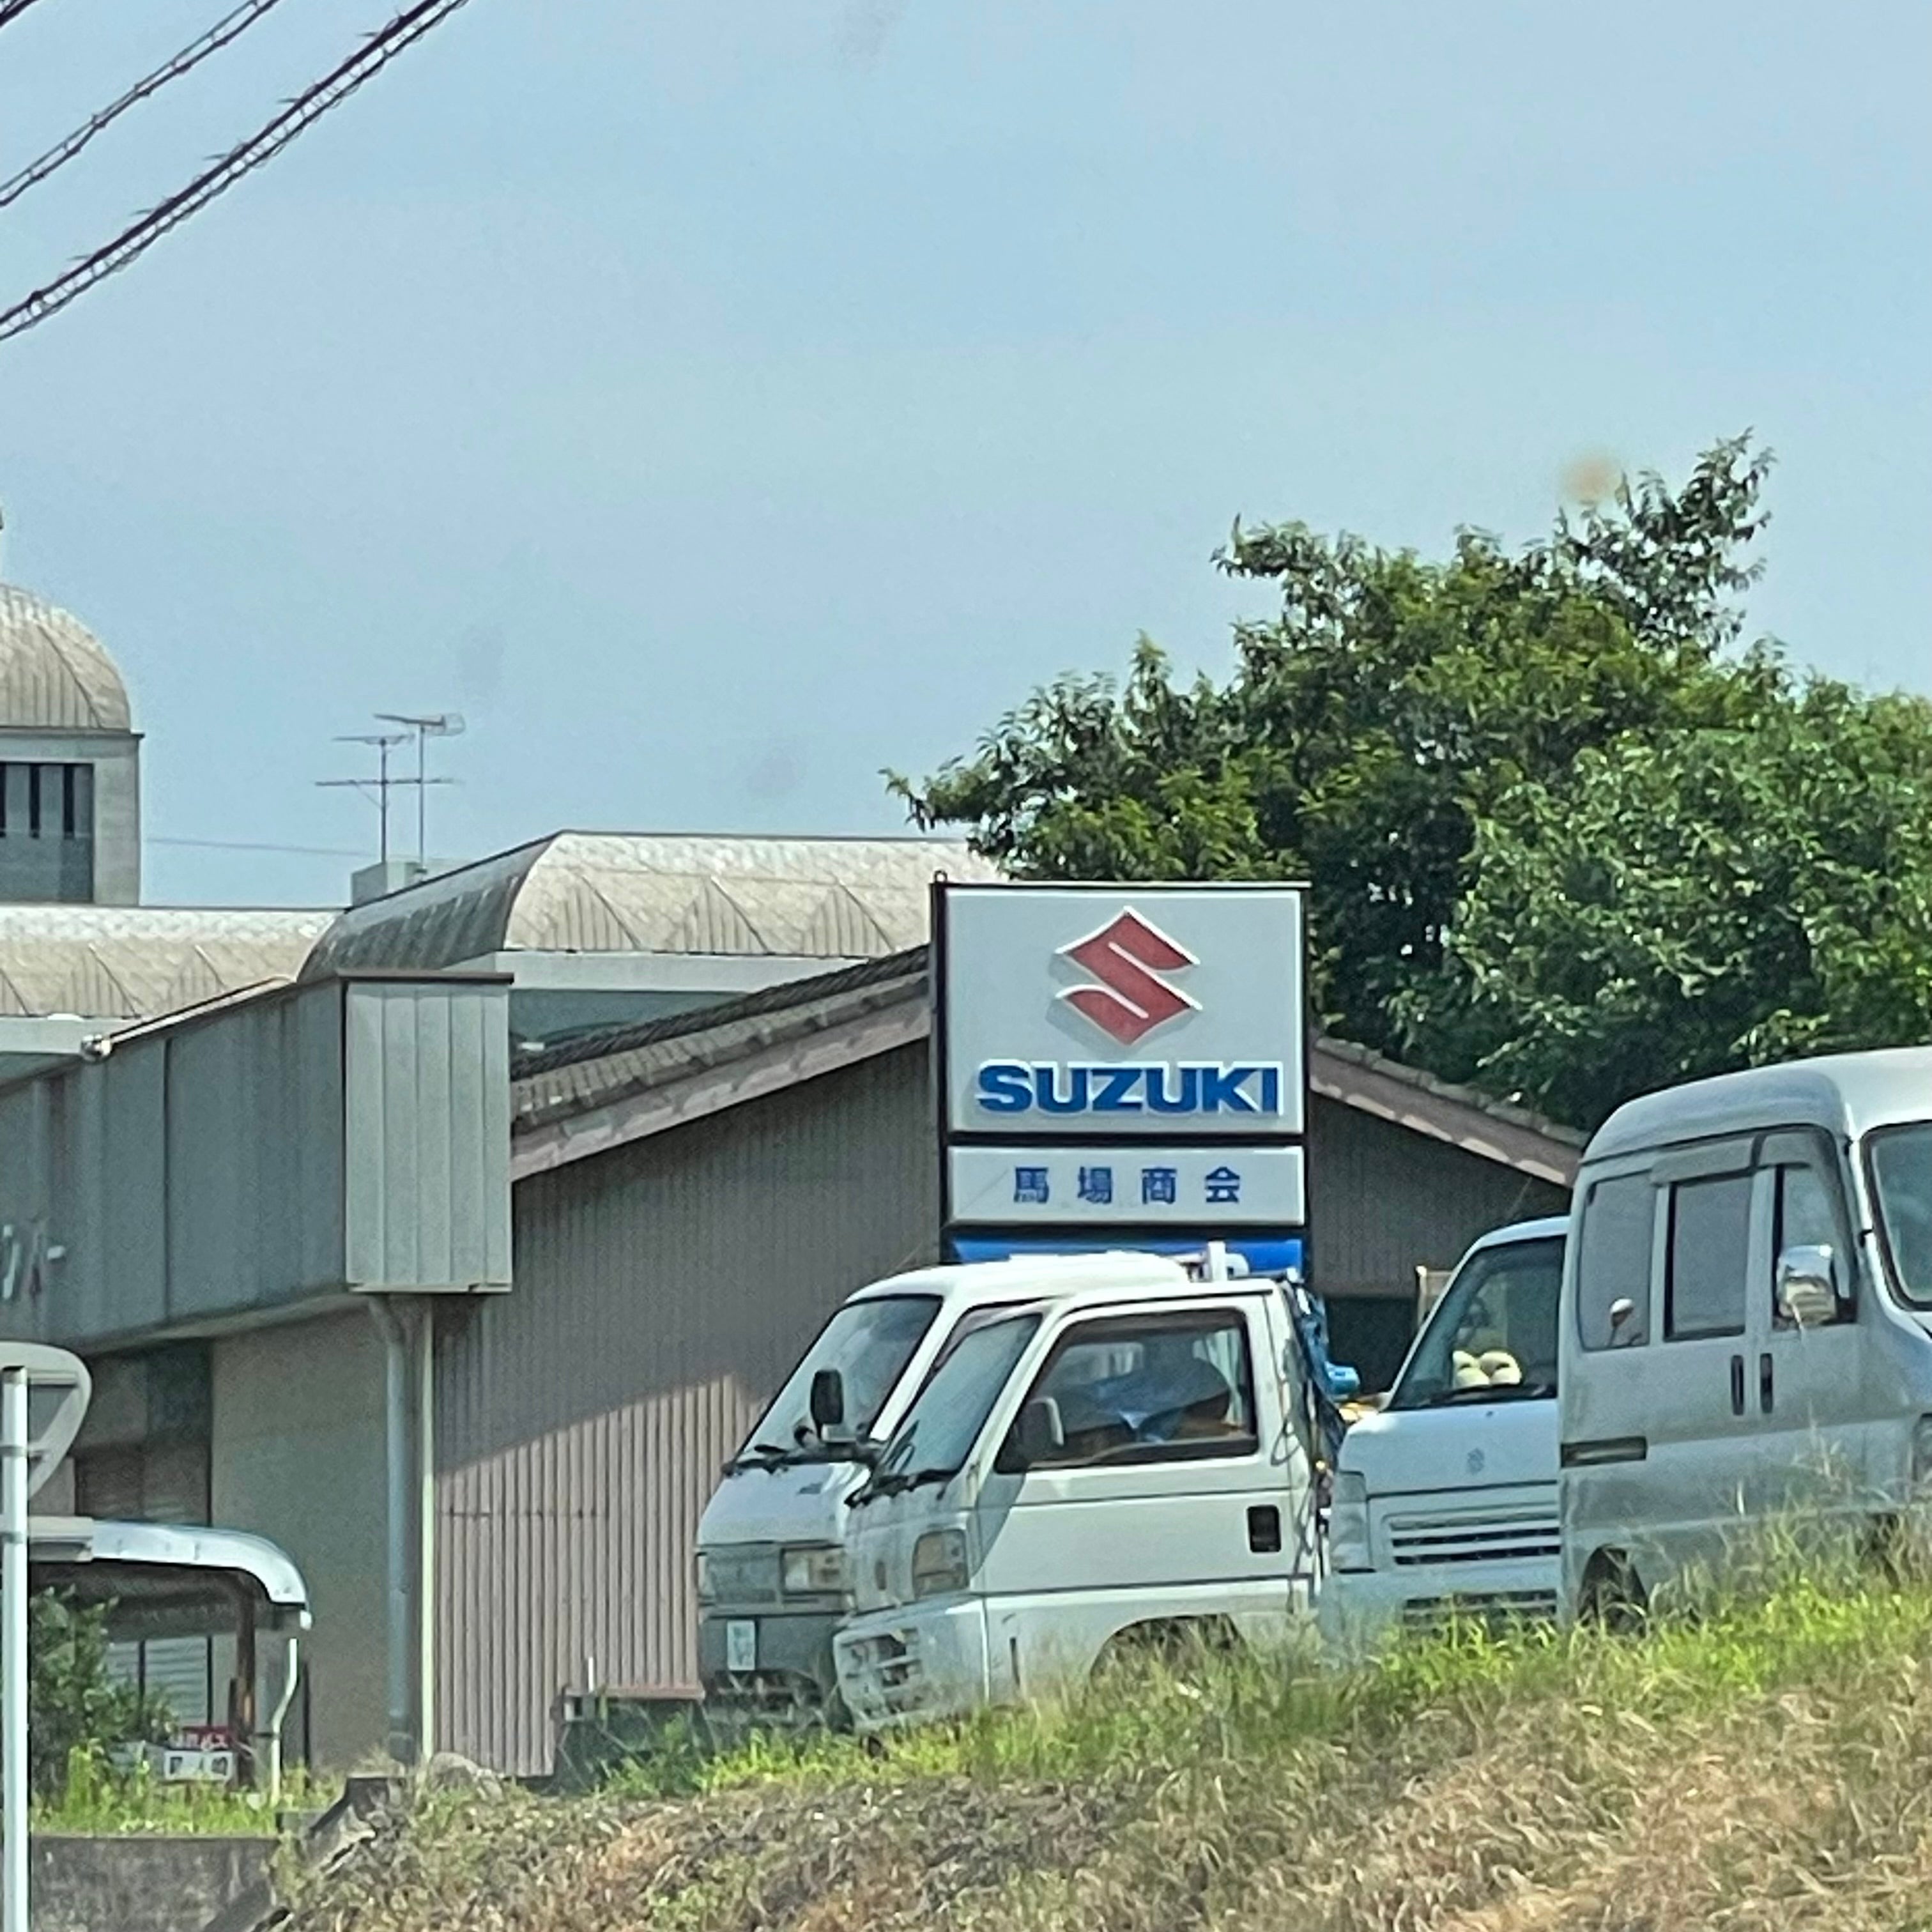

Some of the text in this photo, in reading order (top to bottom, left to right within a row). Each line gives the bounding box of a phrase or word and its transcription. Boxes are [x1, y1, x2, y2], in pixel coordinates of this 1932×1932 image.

[976, 1062, 1280, 1114] SUZUKI
[1013, 1165, 1241, 1205] 馬場商会
